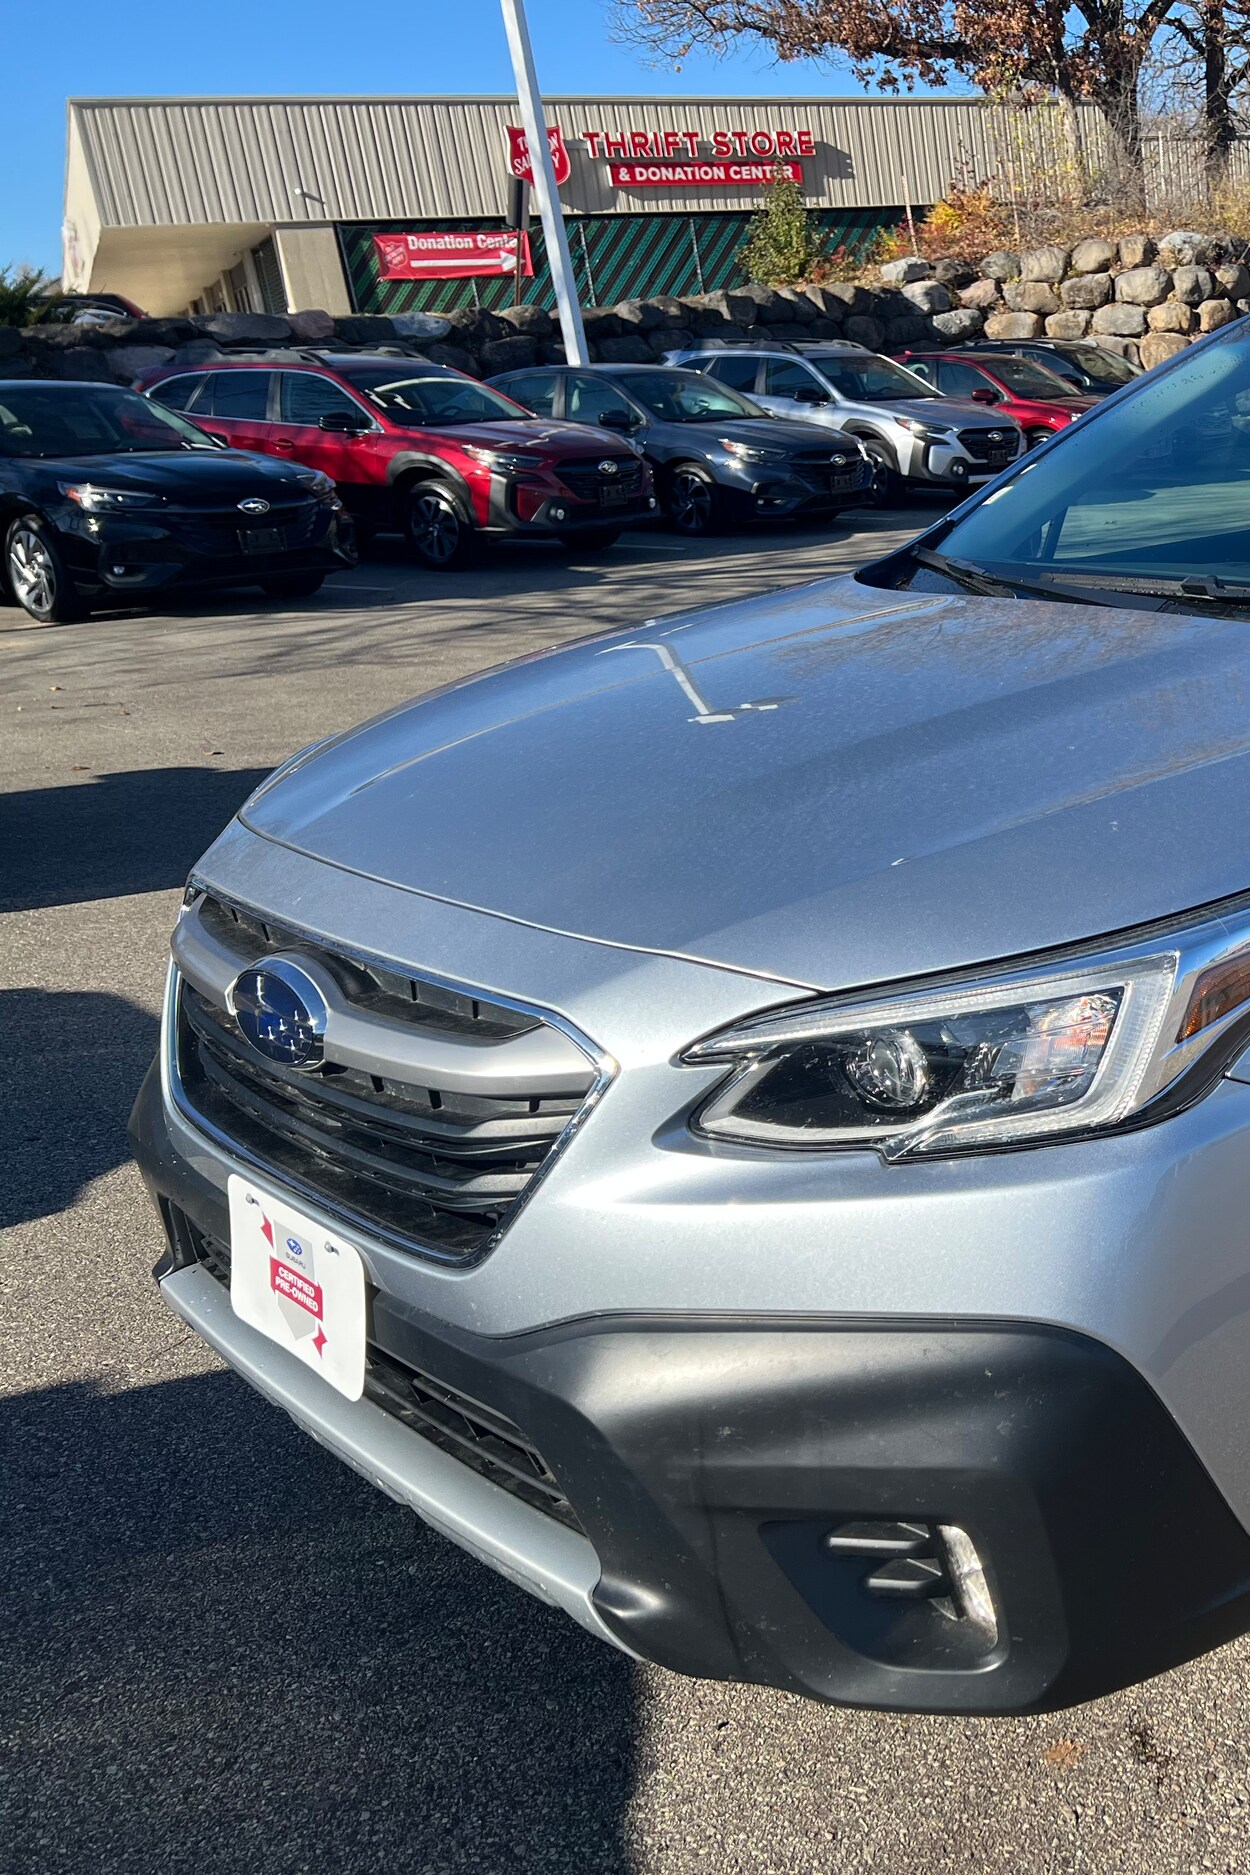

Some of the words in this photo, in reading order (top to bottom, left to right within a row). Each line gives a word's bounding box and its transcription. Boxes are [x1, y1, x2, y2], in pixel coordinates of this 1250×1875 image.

[580, 131, 700, 158] THRIFT
[711, 130, 816, 156] STORE
[618, 167, 631, 181] &
[635, 166, 726, 181] DONATION
[407, 234, 474, 250] Donation
[477, 233, 518, 249] Cente
[285, 1252, 307, 1270] SUBARU
[278, 1266, 316, 1298] CERTIFIED
[275, 1275, 319, 1313] PRE-OWNED
